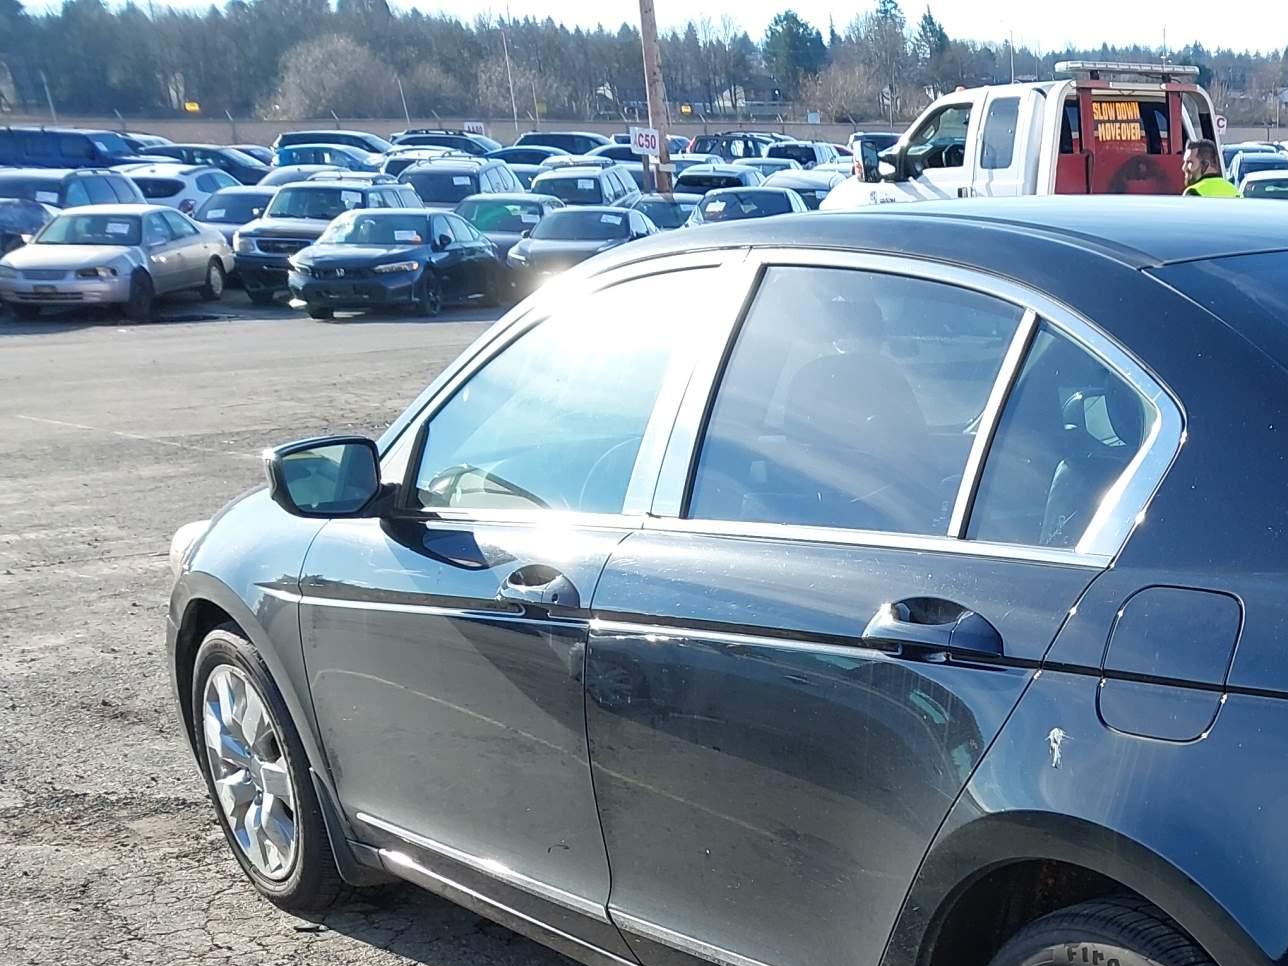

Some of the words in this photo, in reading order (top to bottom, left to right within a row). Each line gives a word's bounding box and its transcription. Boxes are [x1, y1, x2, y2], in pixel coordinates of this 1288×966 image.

[1092, 102, 1115, 120] SLOW
[1116, 102, 1140, 120] DOWN
[1098, 123, 1120, 141] MOVE
[1121, 123, 1141, 141] OVER
